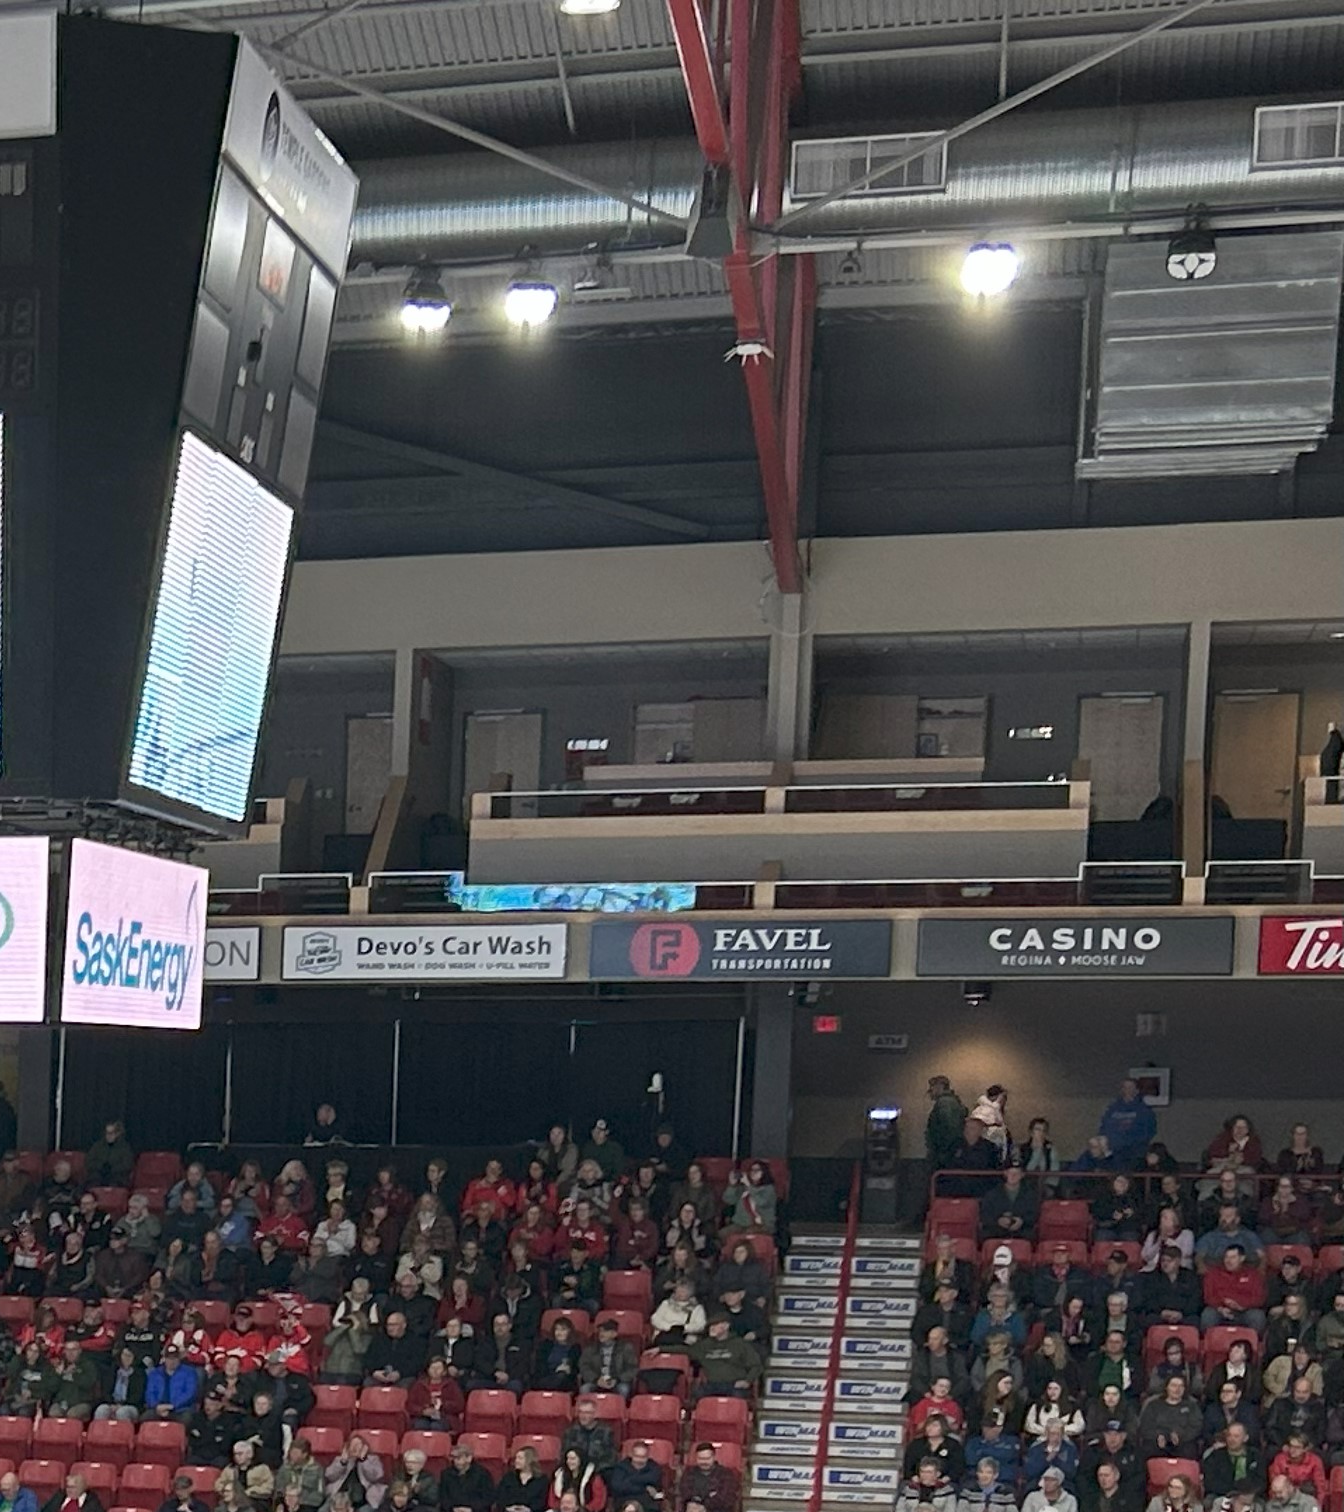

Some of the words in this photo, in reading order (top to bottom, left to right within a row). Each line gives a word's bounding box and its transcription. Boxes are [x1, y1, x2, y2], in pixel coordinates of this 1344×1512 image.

[357, 936, 434, 955] Devo's
[442, 936, 482, 955] Car
[487, 934, 552, 955] Wash
[713, 928, 832, 951] FAVEL
[989, 926, 1162, 951] CASINO
[73, 911, 194, 1011] SaskEnergy
[712, 958, 832, 970] TRANSPORTATION
[1001, 955, 1052, 966] REGINA
[1071, 955, 1117, 966] MOOSE
[1120, 955, 1146, 966] JAW
[865, 1260, 916, 1272] WINMAR
[861, 1300, 911, 1312] WINMAR
[855, 1340, 906, 1353] WINMAR
[851, 1383, 902, 1396] WINMAR
[845, 1427, 897, 1439] WINMAR
[840, 1472, 893, 1484] WINMAR
